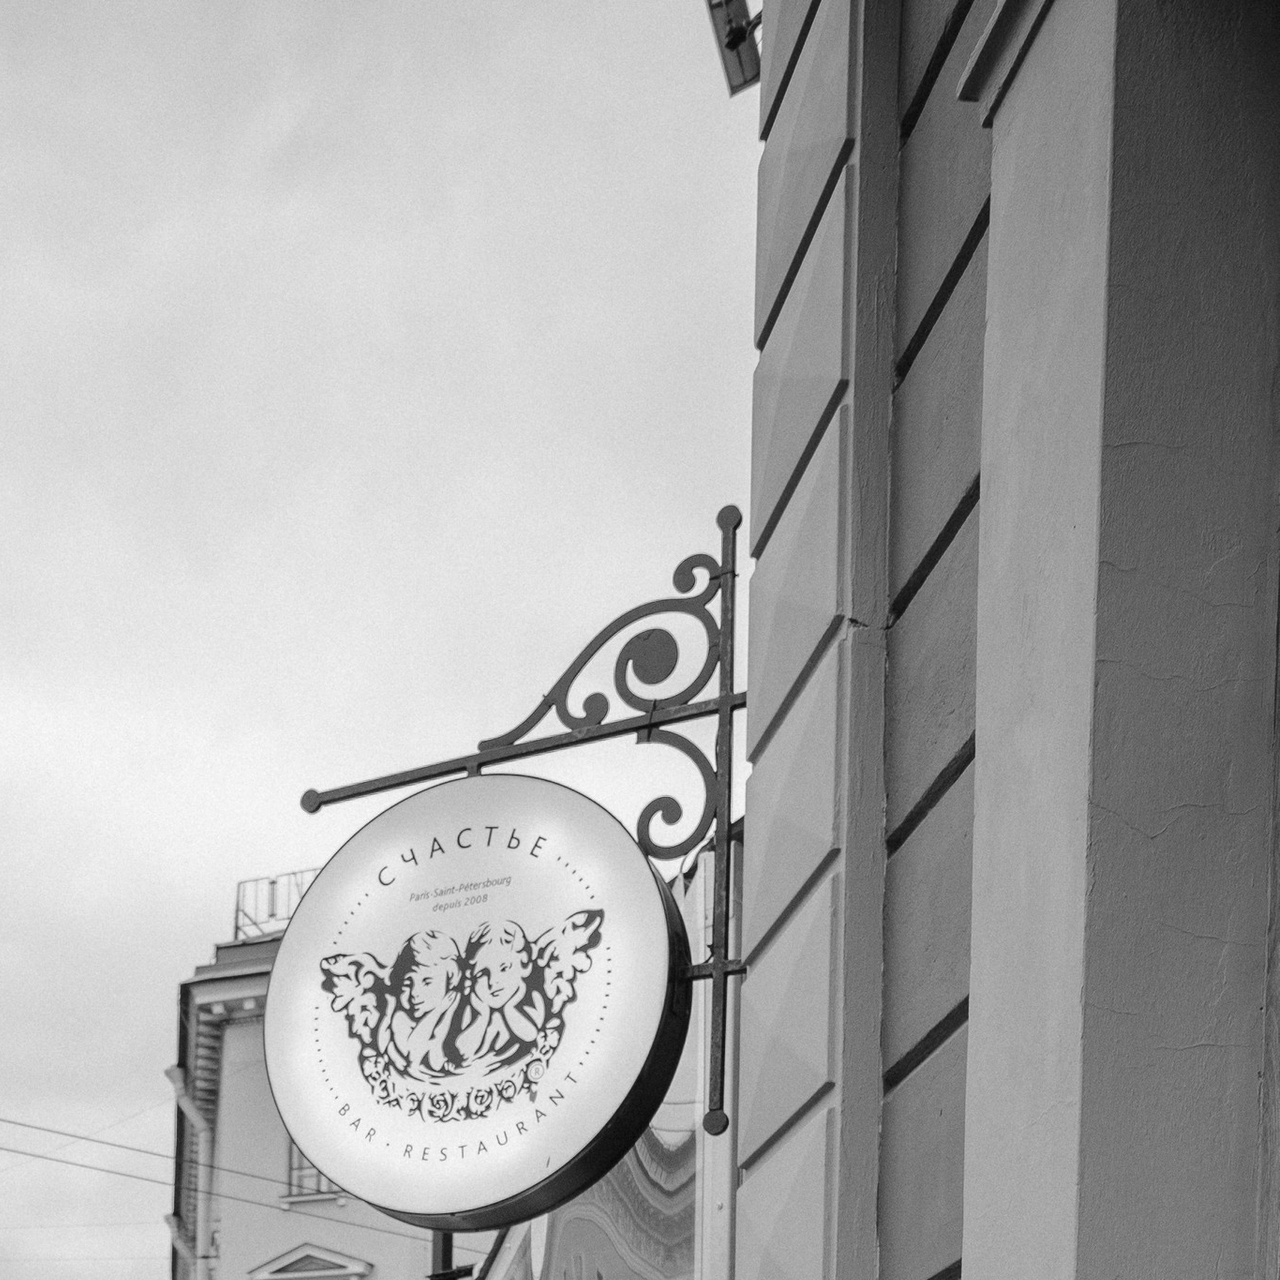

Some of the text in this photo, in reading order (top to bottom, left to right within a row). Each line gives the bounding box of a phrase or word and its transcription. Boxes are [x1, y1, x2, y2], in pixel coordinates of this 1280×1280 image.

[377, 825, 547, 887] СЧАСТЬЕ
[432, 893, 489, 913] depuis 2008
[338, 1074, 578, 1162] BAR RESTAURANT
